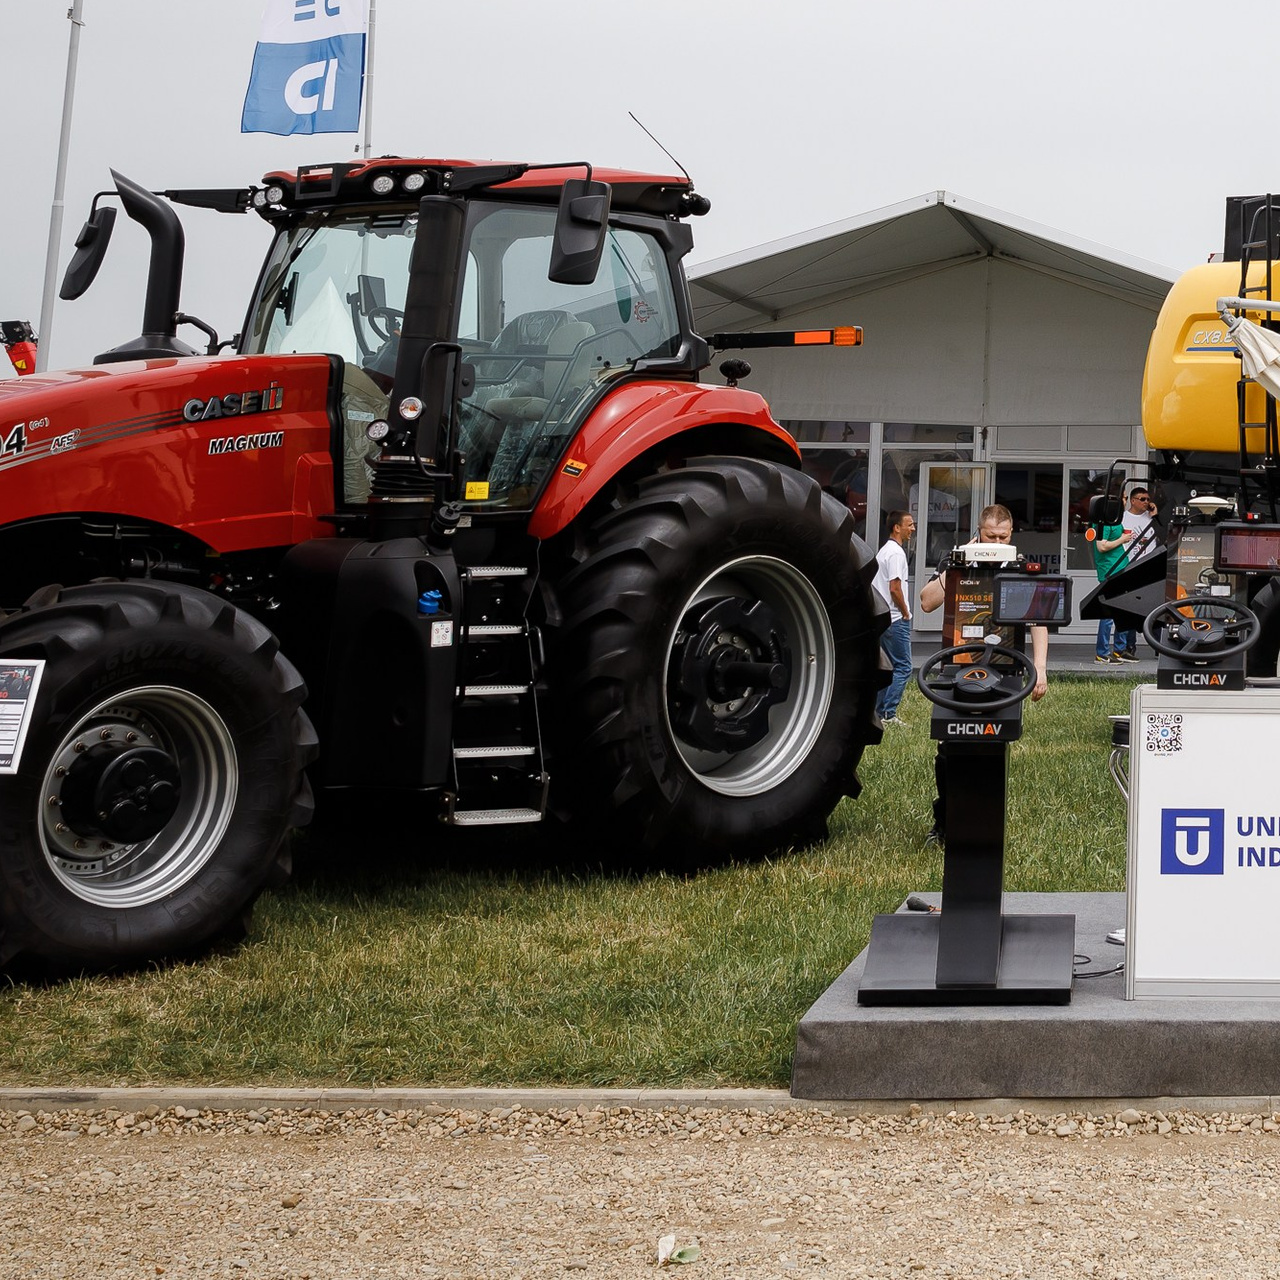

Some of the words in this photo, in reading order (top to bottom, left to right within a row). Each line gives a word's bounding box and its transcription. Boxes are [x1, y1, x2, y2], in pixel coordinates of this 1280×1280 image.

[183, 390, 259, 421] CASE
[0, 422, 28, 457] 4
[50, 431, 76, 451] AFS
[207, 431, 285, 455] MAGNUM
[911, 502, 956, 512] CCNAV
[1173, 673, 1227, 686] CHCNAV
[947, 723, 1002, 735] CHCNAV
